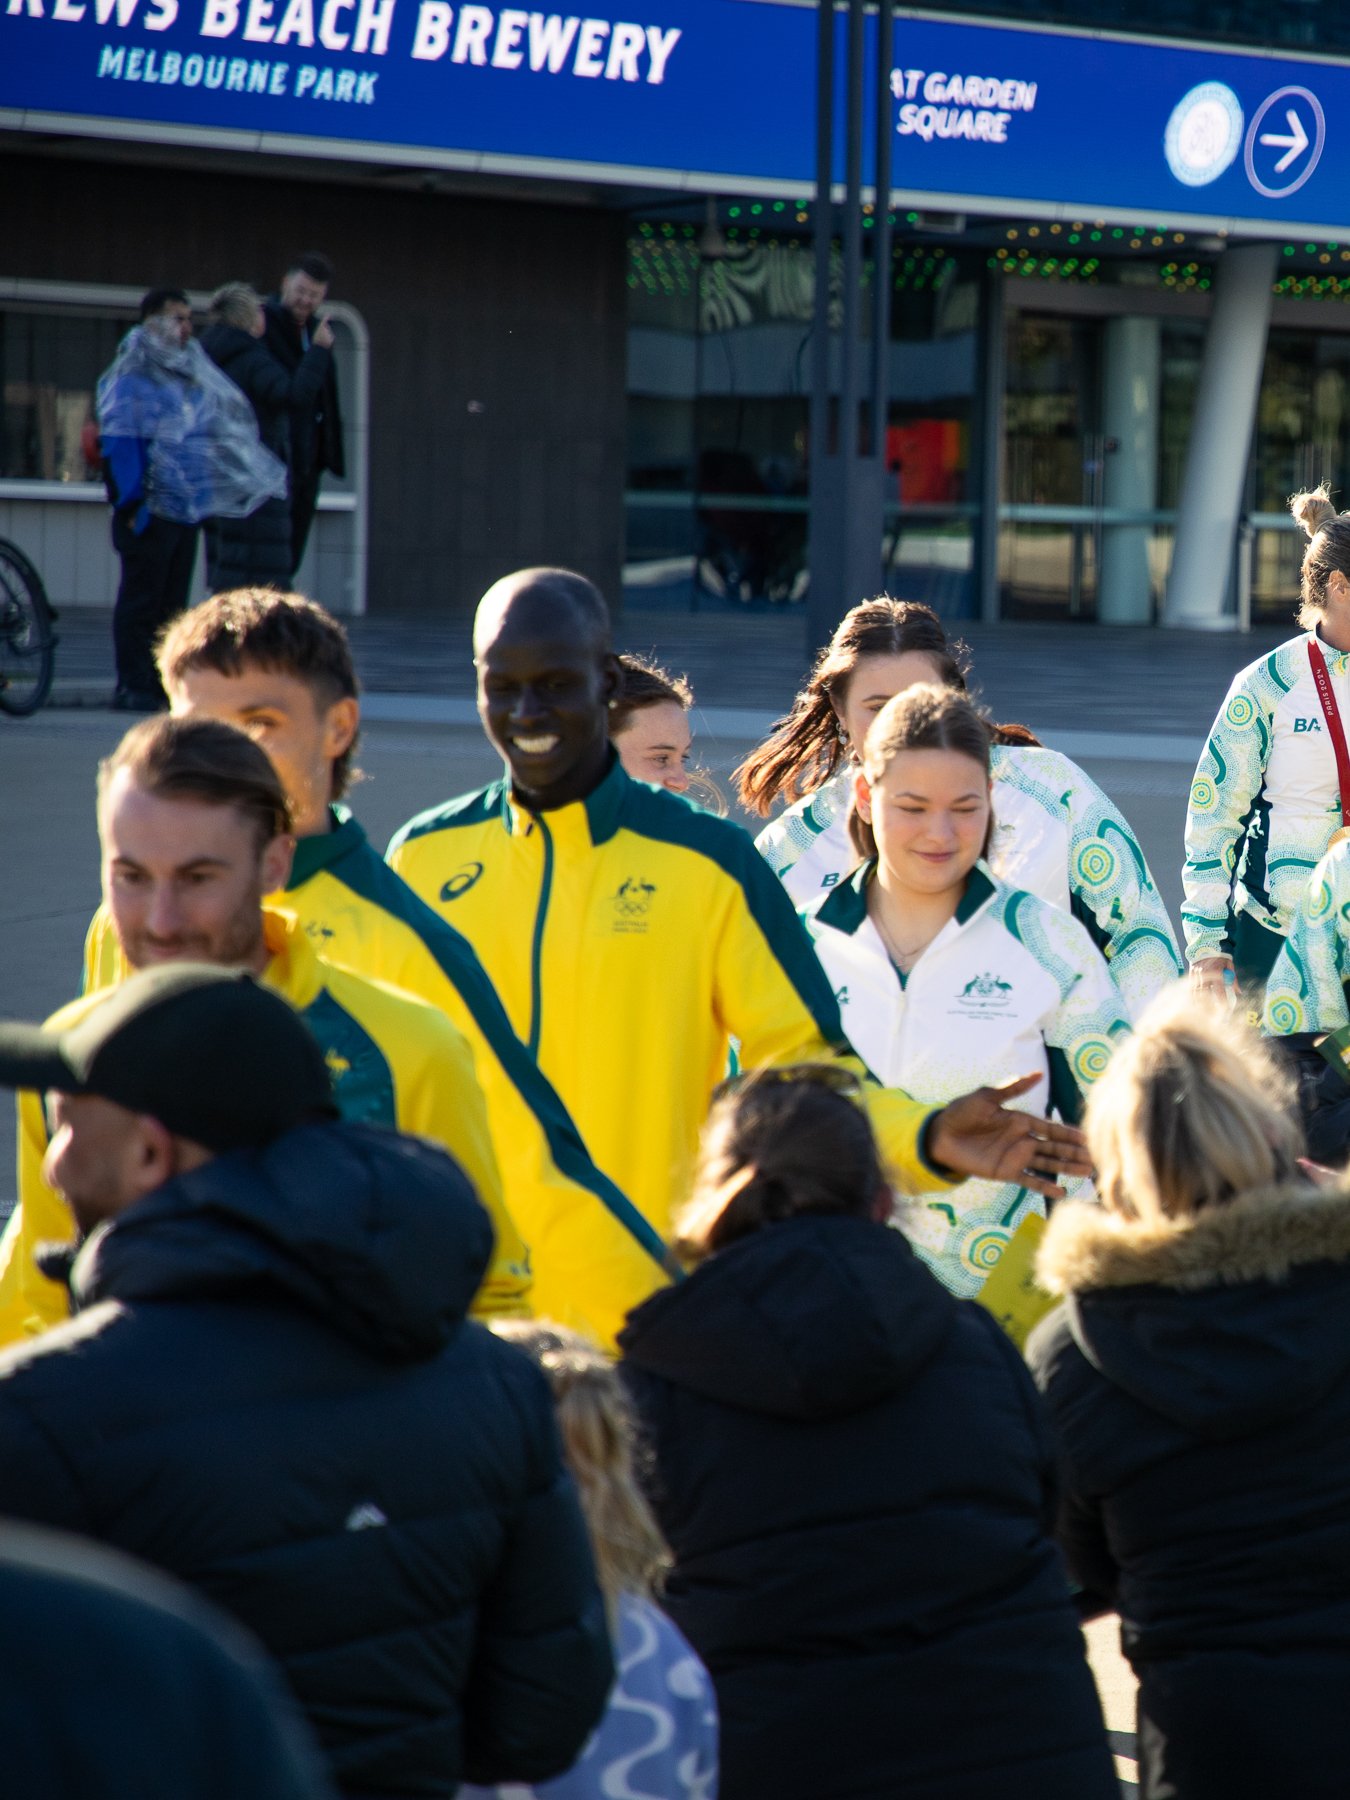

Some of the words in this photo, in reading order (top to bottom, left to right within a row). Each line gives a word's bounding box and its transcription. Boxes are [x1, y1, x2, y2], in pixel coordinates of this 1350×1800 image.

[199, 0, 396, 55] BEACH
[410, 0, 682, 84] BREWERY
[97, 44, 289, 96] MELBOURNE
[293, 64, 379, 105] PARK
[923, 71, 1038, 112] GARDEN
[896, 103, 1012, 143] SQUARE
[1316, 668, 1328, 691] 2024
[1322, 692, 1334, 716] PARIS
